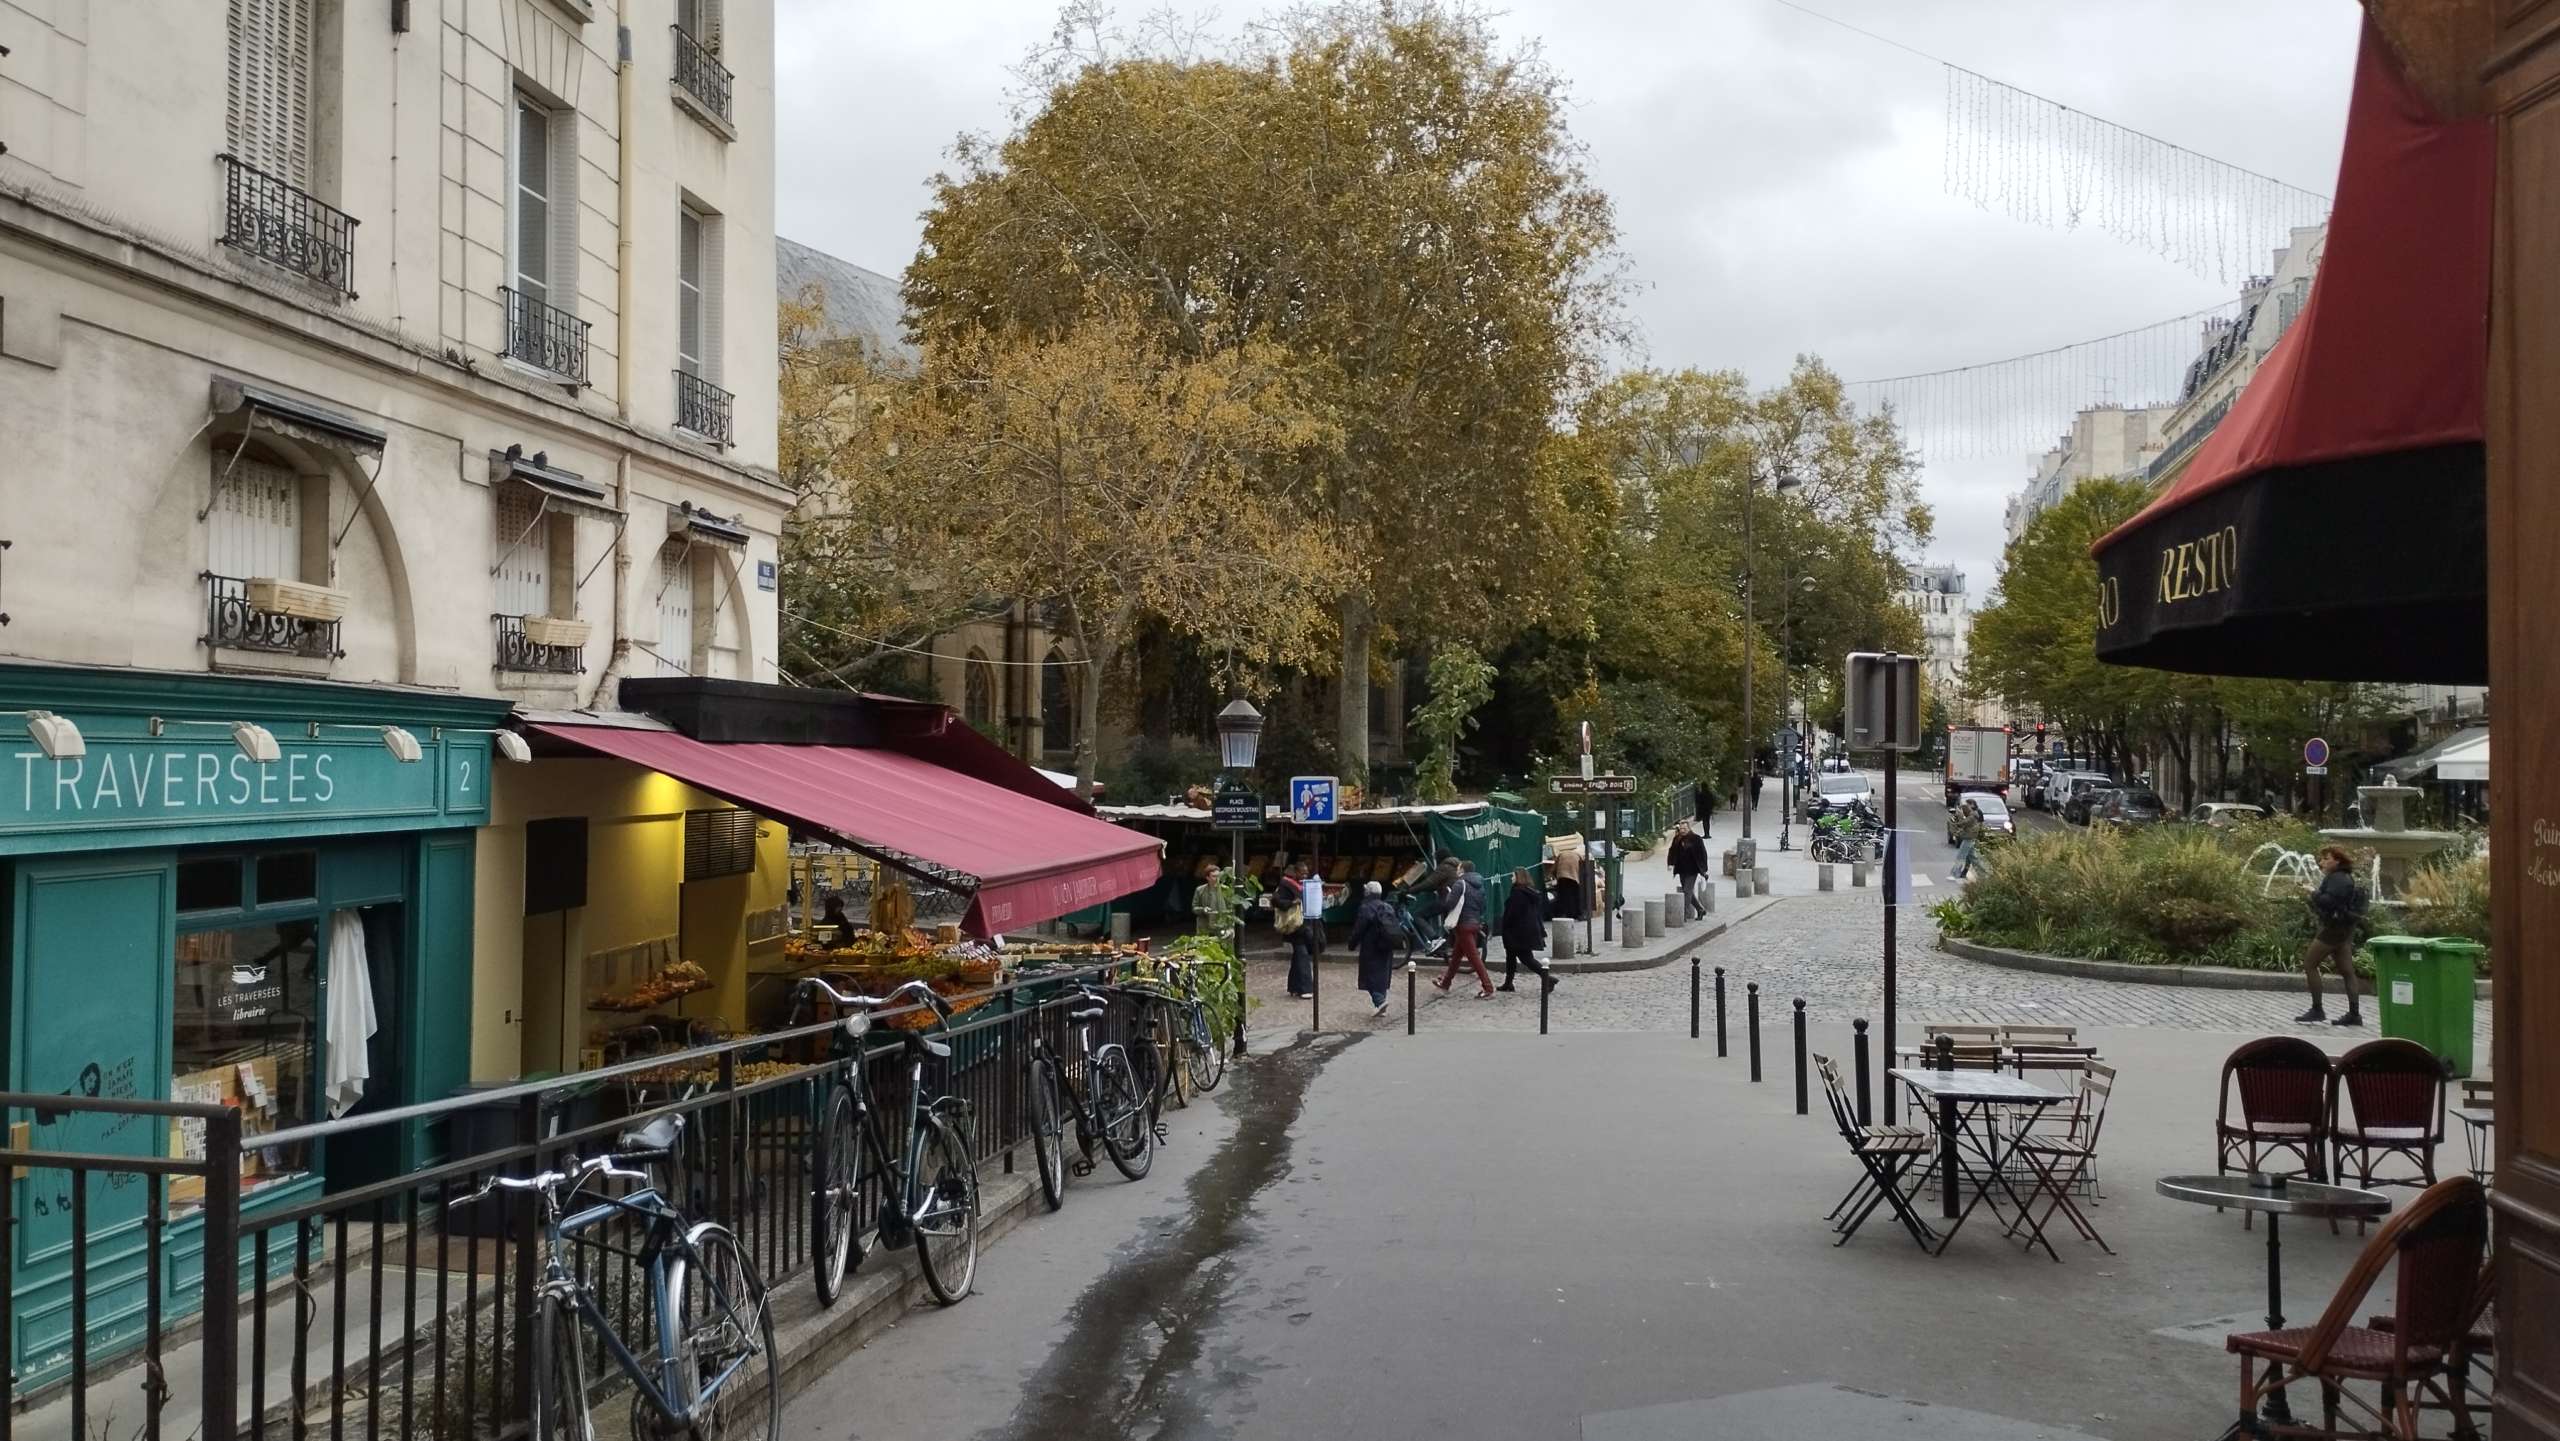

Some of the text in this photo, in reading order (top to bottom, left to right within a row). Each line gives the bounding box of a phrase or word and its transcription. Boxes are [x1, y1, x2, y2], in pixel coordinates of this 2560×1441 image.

[2157, 525, 2238, 604] RESTO
[459, 760, 471, 792] 2
[217, 986, 281, 1008] LES TRAVERSÉES
[233, 1005, 267, 1021] librairie
